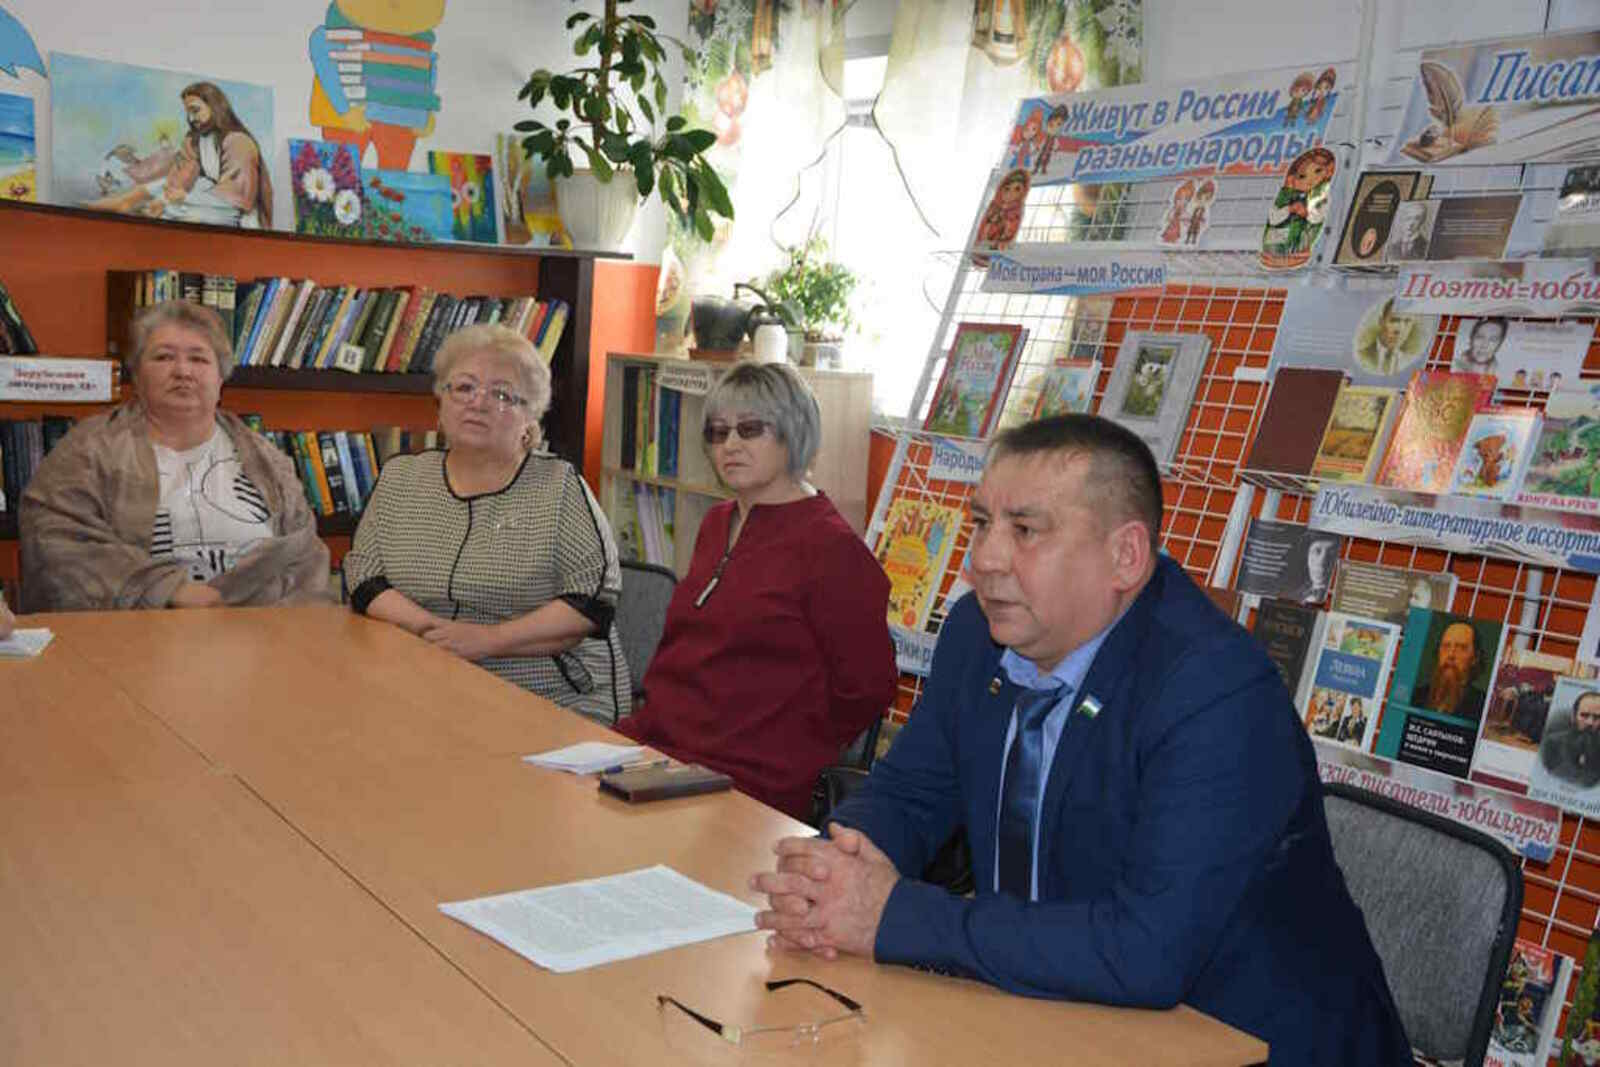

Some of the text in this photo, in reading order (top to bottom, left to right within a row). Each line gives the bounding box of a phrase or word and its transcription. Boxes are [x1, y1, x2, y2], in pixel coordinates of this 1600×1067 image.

[1065, 90, 1280, 137] Живут в России
[1072, 145, 1180, 180] разные
[990, 261, 1017, 281] Моя
[1111, 262, 1162, 283] Россия
[1361, 770, 1555, 846] писатели-юбиляры
